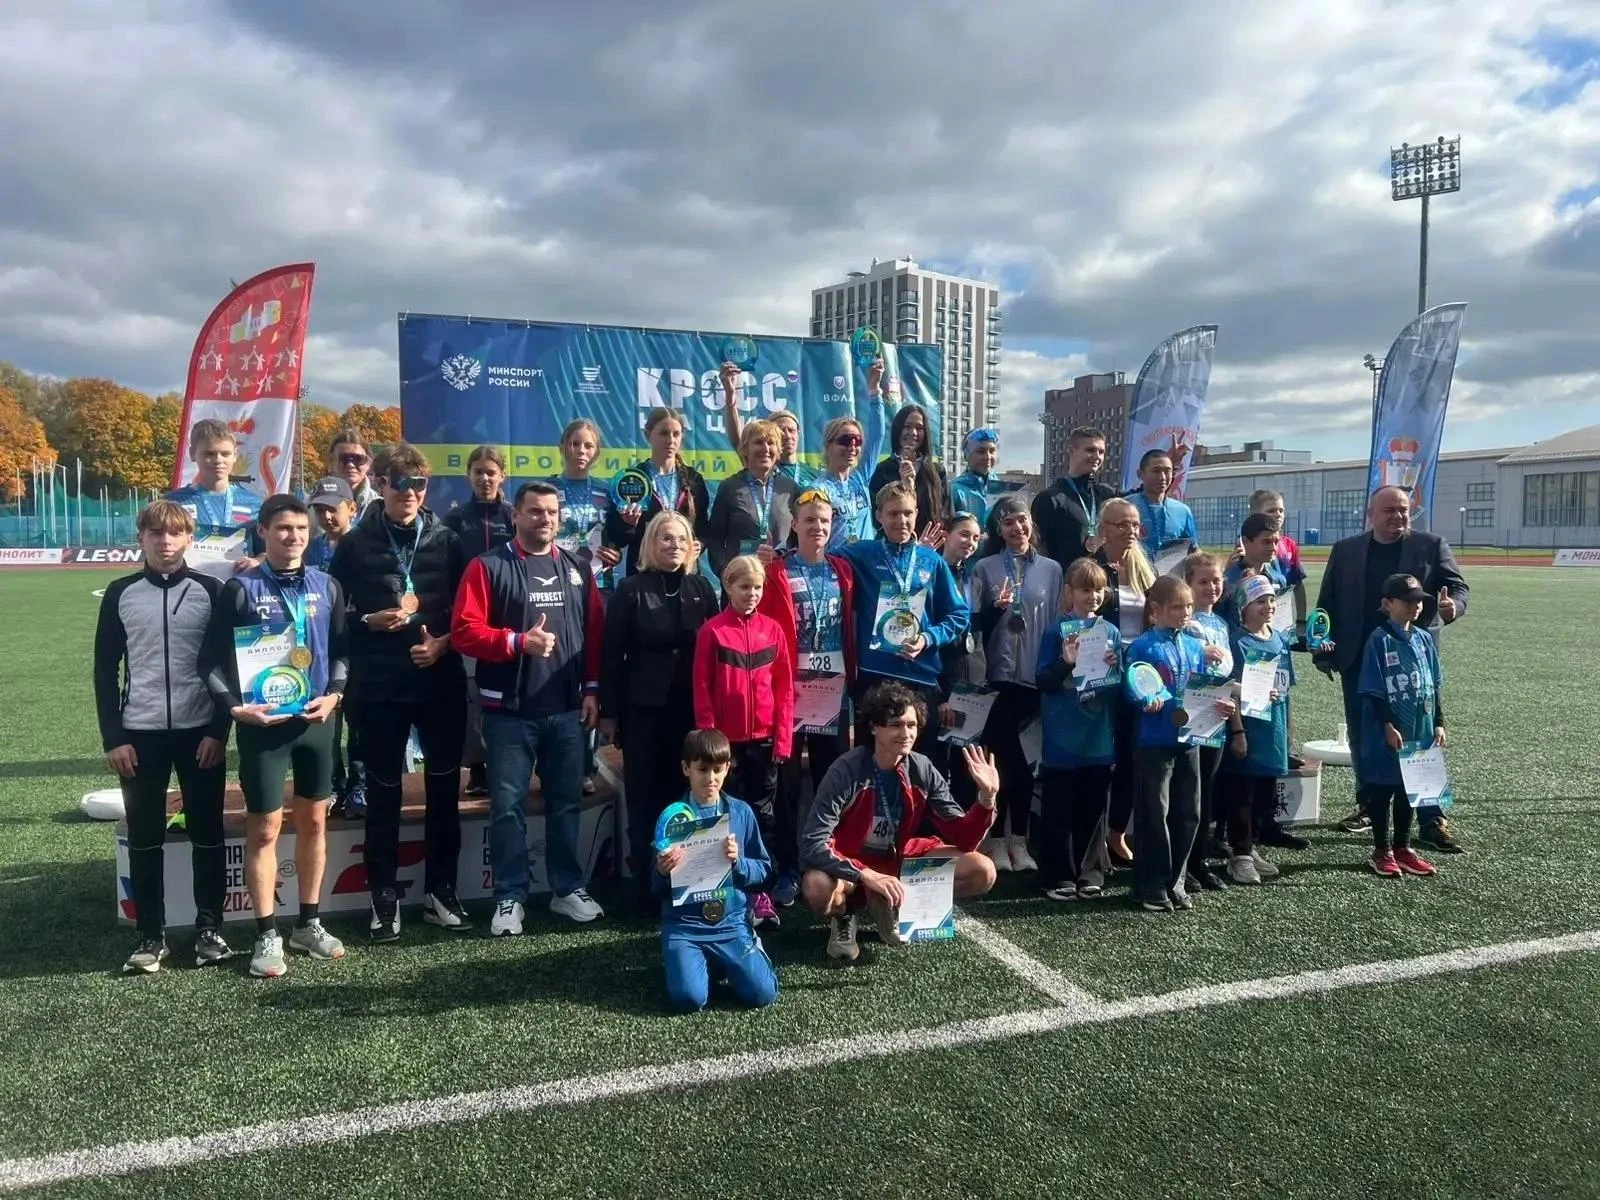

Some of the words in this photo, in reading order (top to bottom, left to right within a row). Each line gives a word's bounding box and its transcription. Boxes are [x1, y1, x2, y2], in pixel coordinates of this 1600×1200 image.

[488, 366, 543, 377] МИНСПОРТ
[488, 377, 530, 388] РОССИИ
[638, 367, 787, 412] КРОСС
[0, 550, 45, 559] НОЛИТ
[76, 549, 142, 562] LEON
[809, 655, 832, 671] 328
